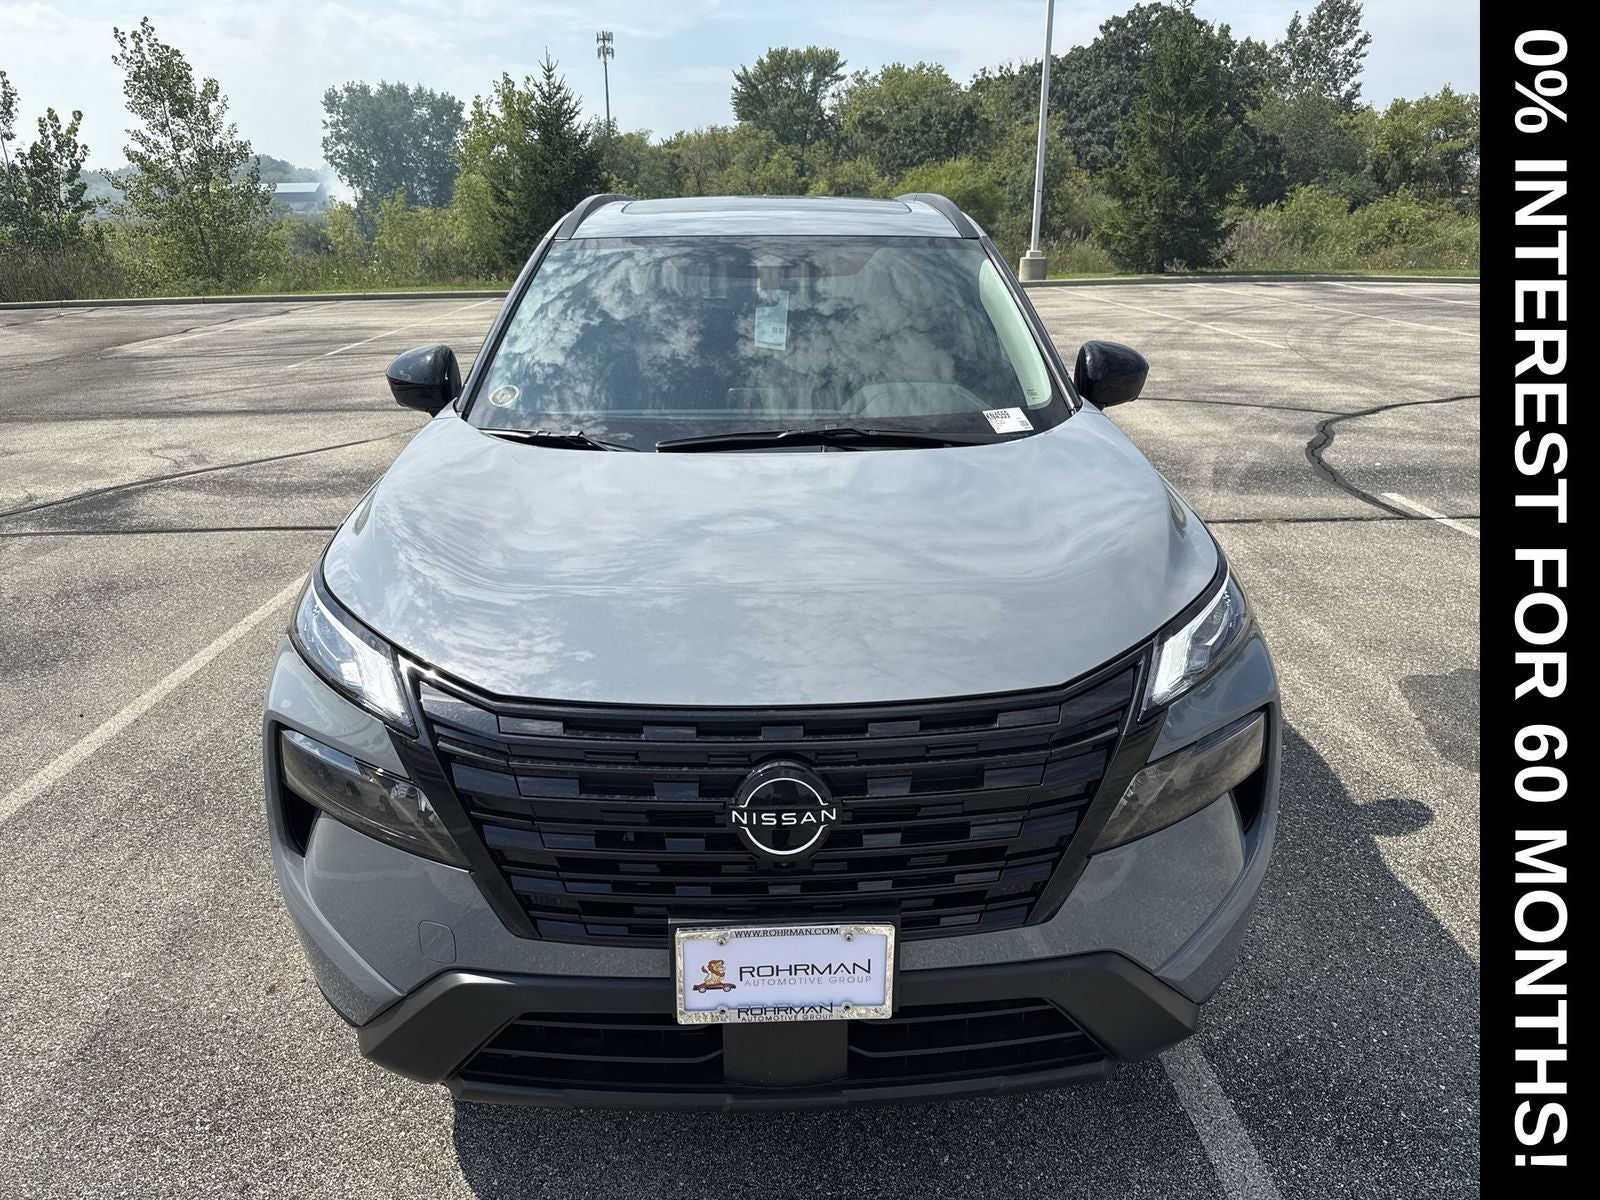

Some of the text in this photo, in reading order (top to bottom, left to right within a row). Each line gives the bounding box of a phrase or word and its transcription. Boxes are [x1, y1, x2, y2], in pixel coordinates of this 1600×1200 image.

[731, 807, 837, 826] NISSAN
[734, 927, 840, 938] WWW.ROHRMAN.COM
[739, 958, 872, 982] ROHRMAN
[744, 975, 872, 987] AUTOMOTIVE GROUP
[737, 1002, 833, 1019] ROHRMAN
[741, 1012, 834, 1023] AUTOMOTIVE GROUP
